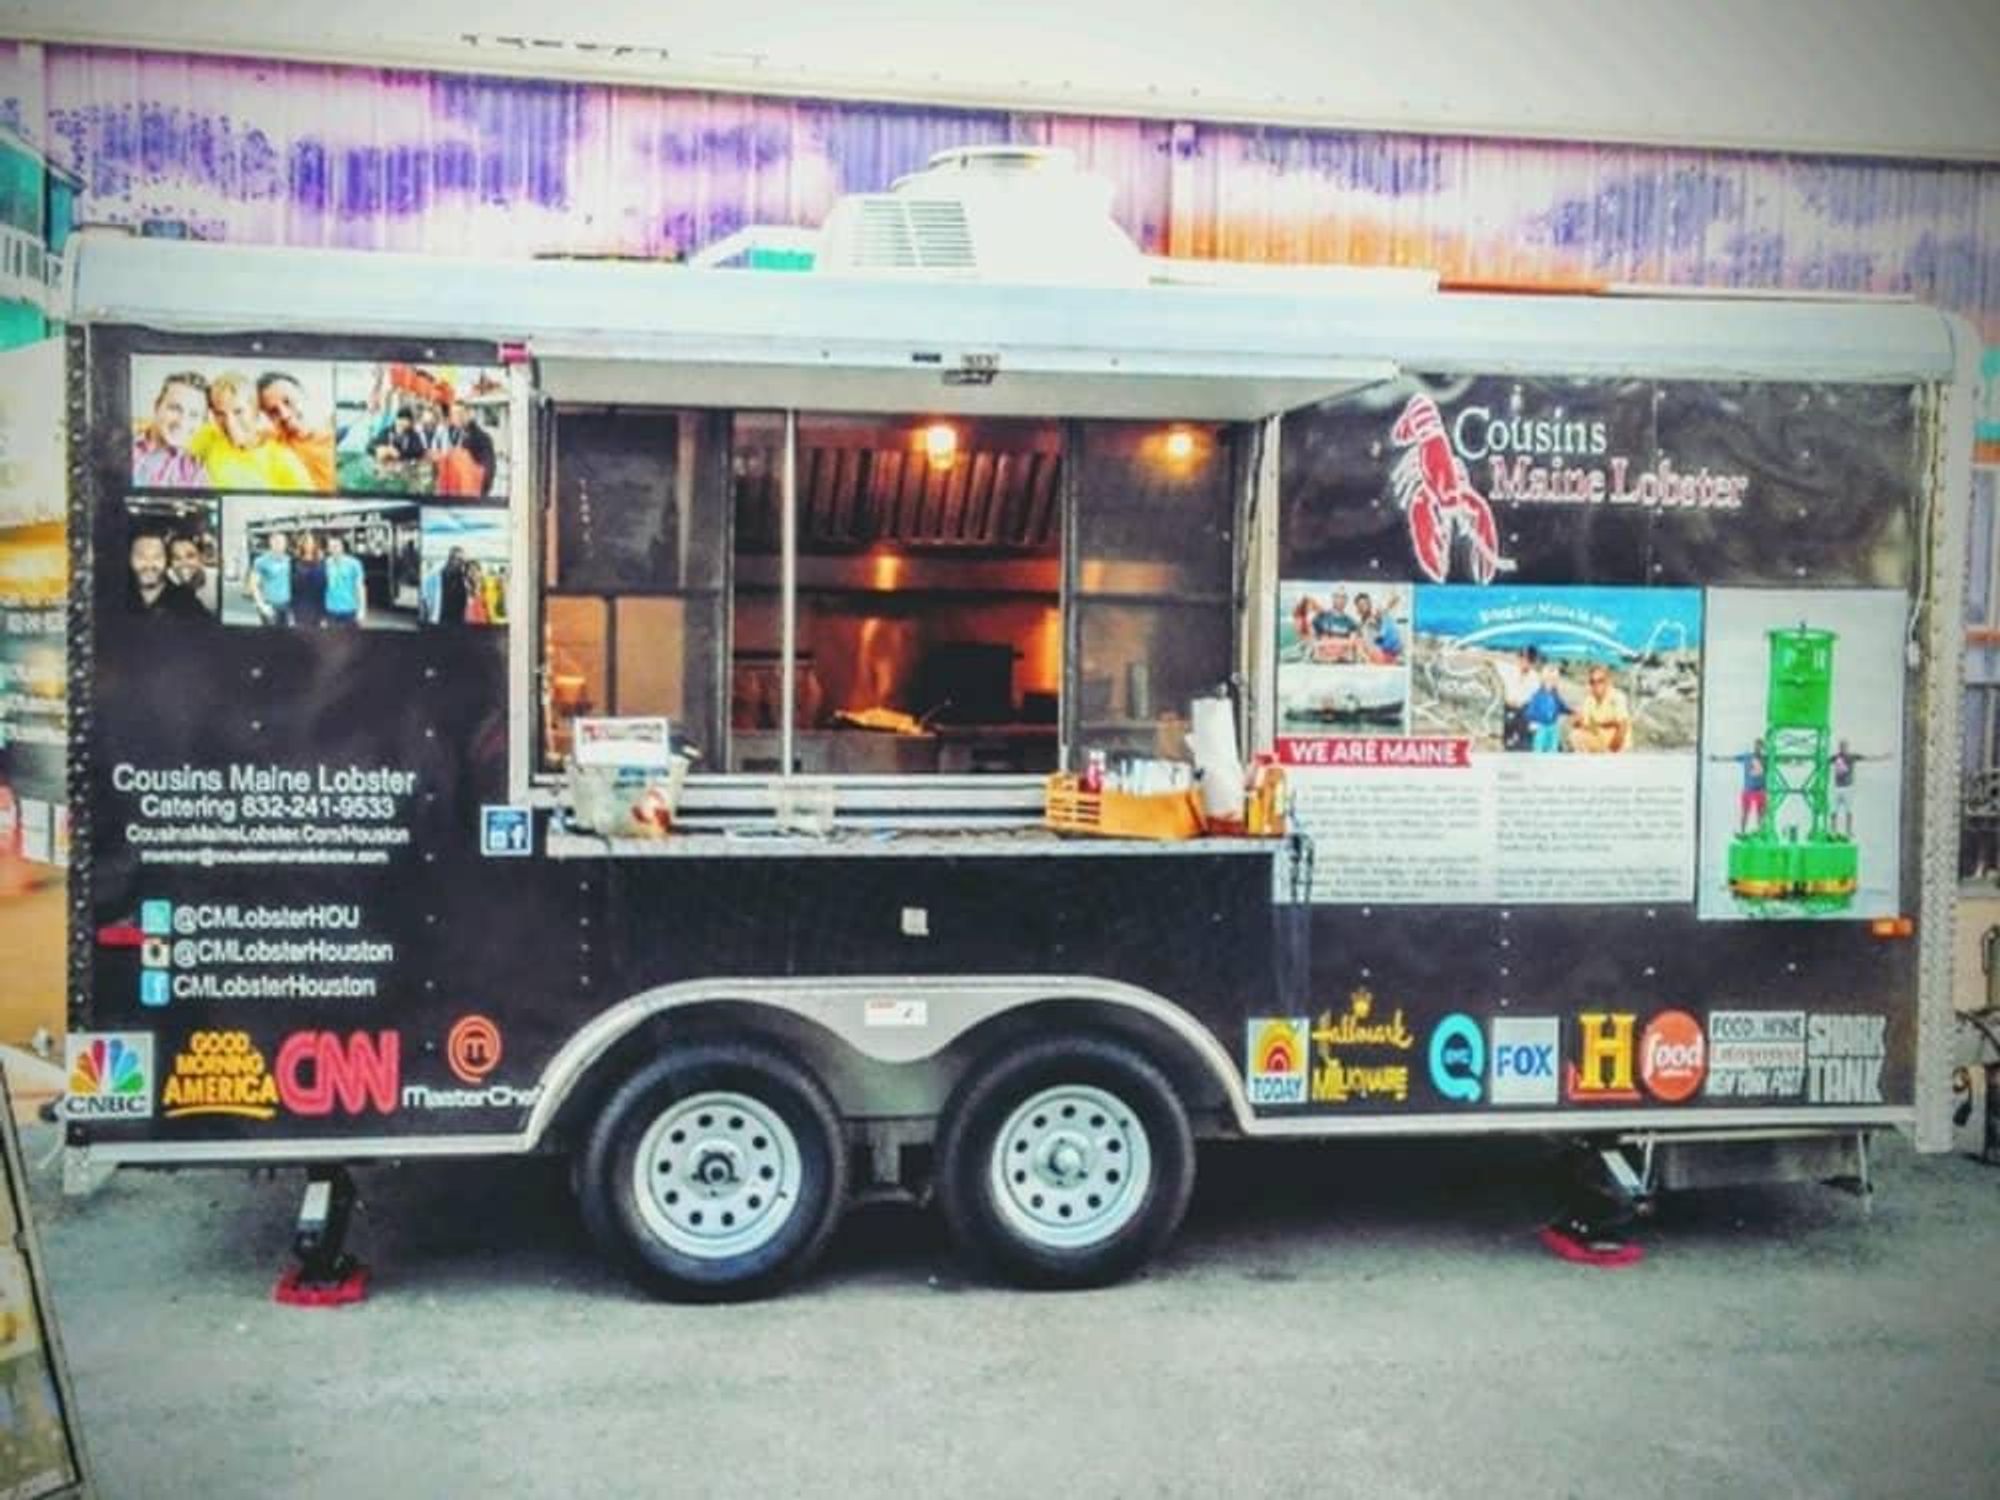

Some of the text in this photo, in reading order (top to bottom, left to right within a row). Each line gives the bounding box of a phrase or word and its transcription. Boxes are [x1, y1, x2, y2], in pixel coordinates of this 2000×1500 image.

[1453, 406, 1607, 460] Cousins
[1488, 455, 1749, 508] Maine Lobster
[1290, 741, 1458, 764] WE ARE MAINE
[112, 763, 417, 796] Cousins Maine Lobster
[141, 794, 237, 823] Catering
[173, 904, 360, 935] @CMLobsterHOU
[173, 937, 394, 969] @CMLobsterHouston
[173, 972, 377, 998] CMLobsterHouston
[190, 1030, 251, 1053] GOOD
[1312, 1008, 1415, 1064] Hallmark
[1578, 1013, 1637, 1089] H
[175, 1051, 265, 1077] MORNING
[1496, 1044, 1553, 1078] FOX
[1641, 1026, 1704, 1082] food
[275, 1029, 400, 1116] CNN
[1253, 1076, 1304, 1101] TODAY
[1807, 1057, 1885, 1103] TANK
[65, 1095, 147, 1114] CNBC
[162, 1074, 278, 1105] AMERICA
